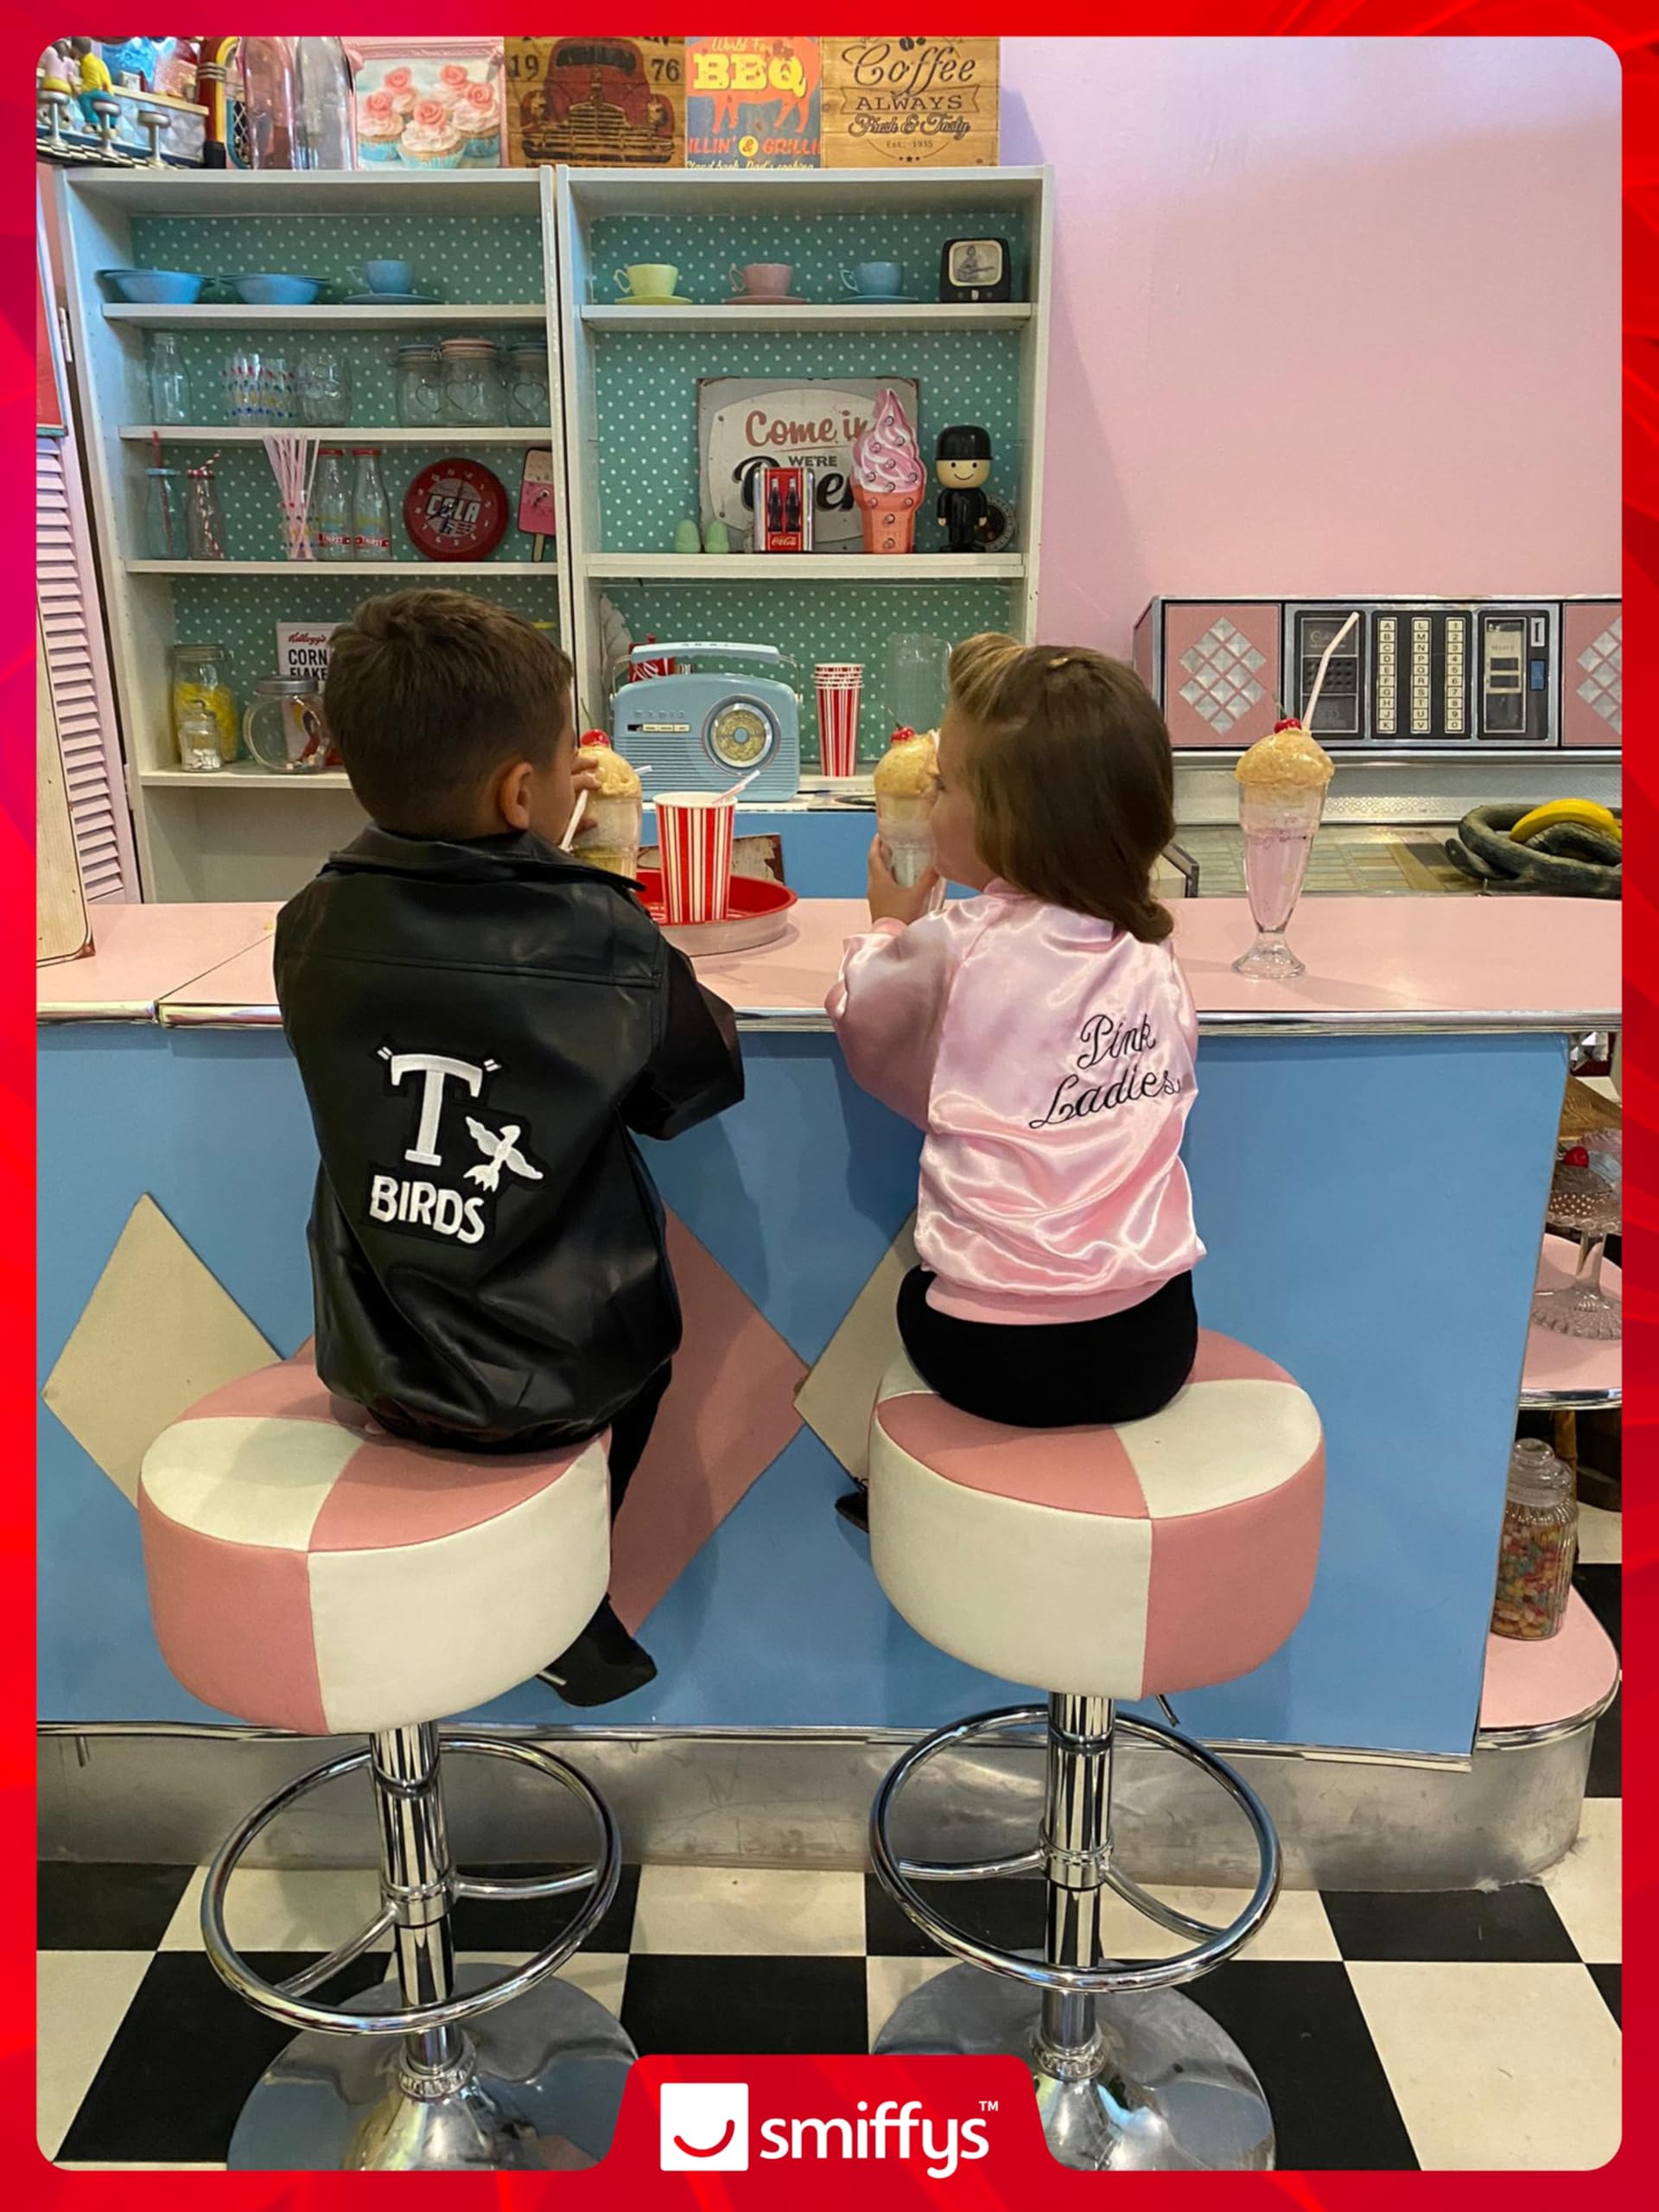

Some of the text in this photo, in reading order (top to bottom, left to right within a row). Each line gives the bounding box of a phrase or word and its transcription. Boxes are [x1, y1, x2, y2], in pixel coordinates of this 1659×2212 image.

[508, 54, 539, 81] 19
[652, 58, 680, 82] 76
[693, 53, 807, 98] BBQ
[842, 43, 976, 96] Coffee
[855, 94, 963, 111] ALWAYS
[919, 112, 971, 141] Tasty
[745, 410, 836, 448] Come
[788, 455, 837, 467] WE'RE
[288, 649, 327, 665] CORN
[1077, 1014, 1156, 1070] Pink
[391, 1052, 483, 1166] T
[1028, 1065, 1180, 1129] Ladies
[369, 1174, 486, 1244] BIRDS
